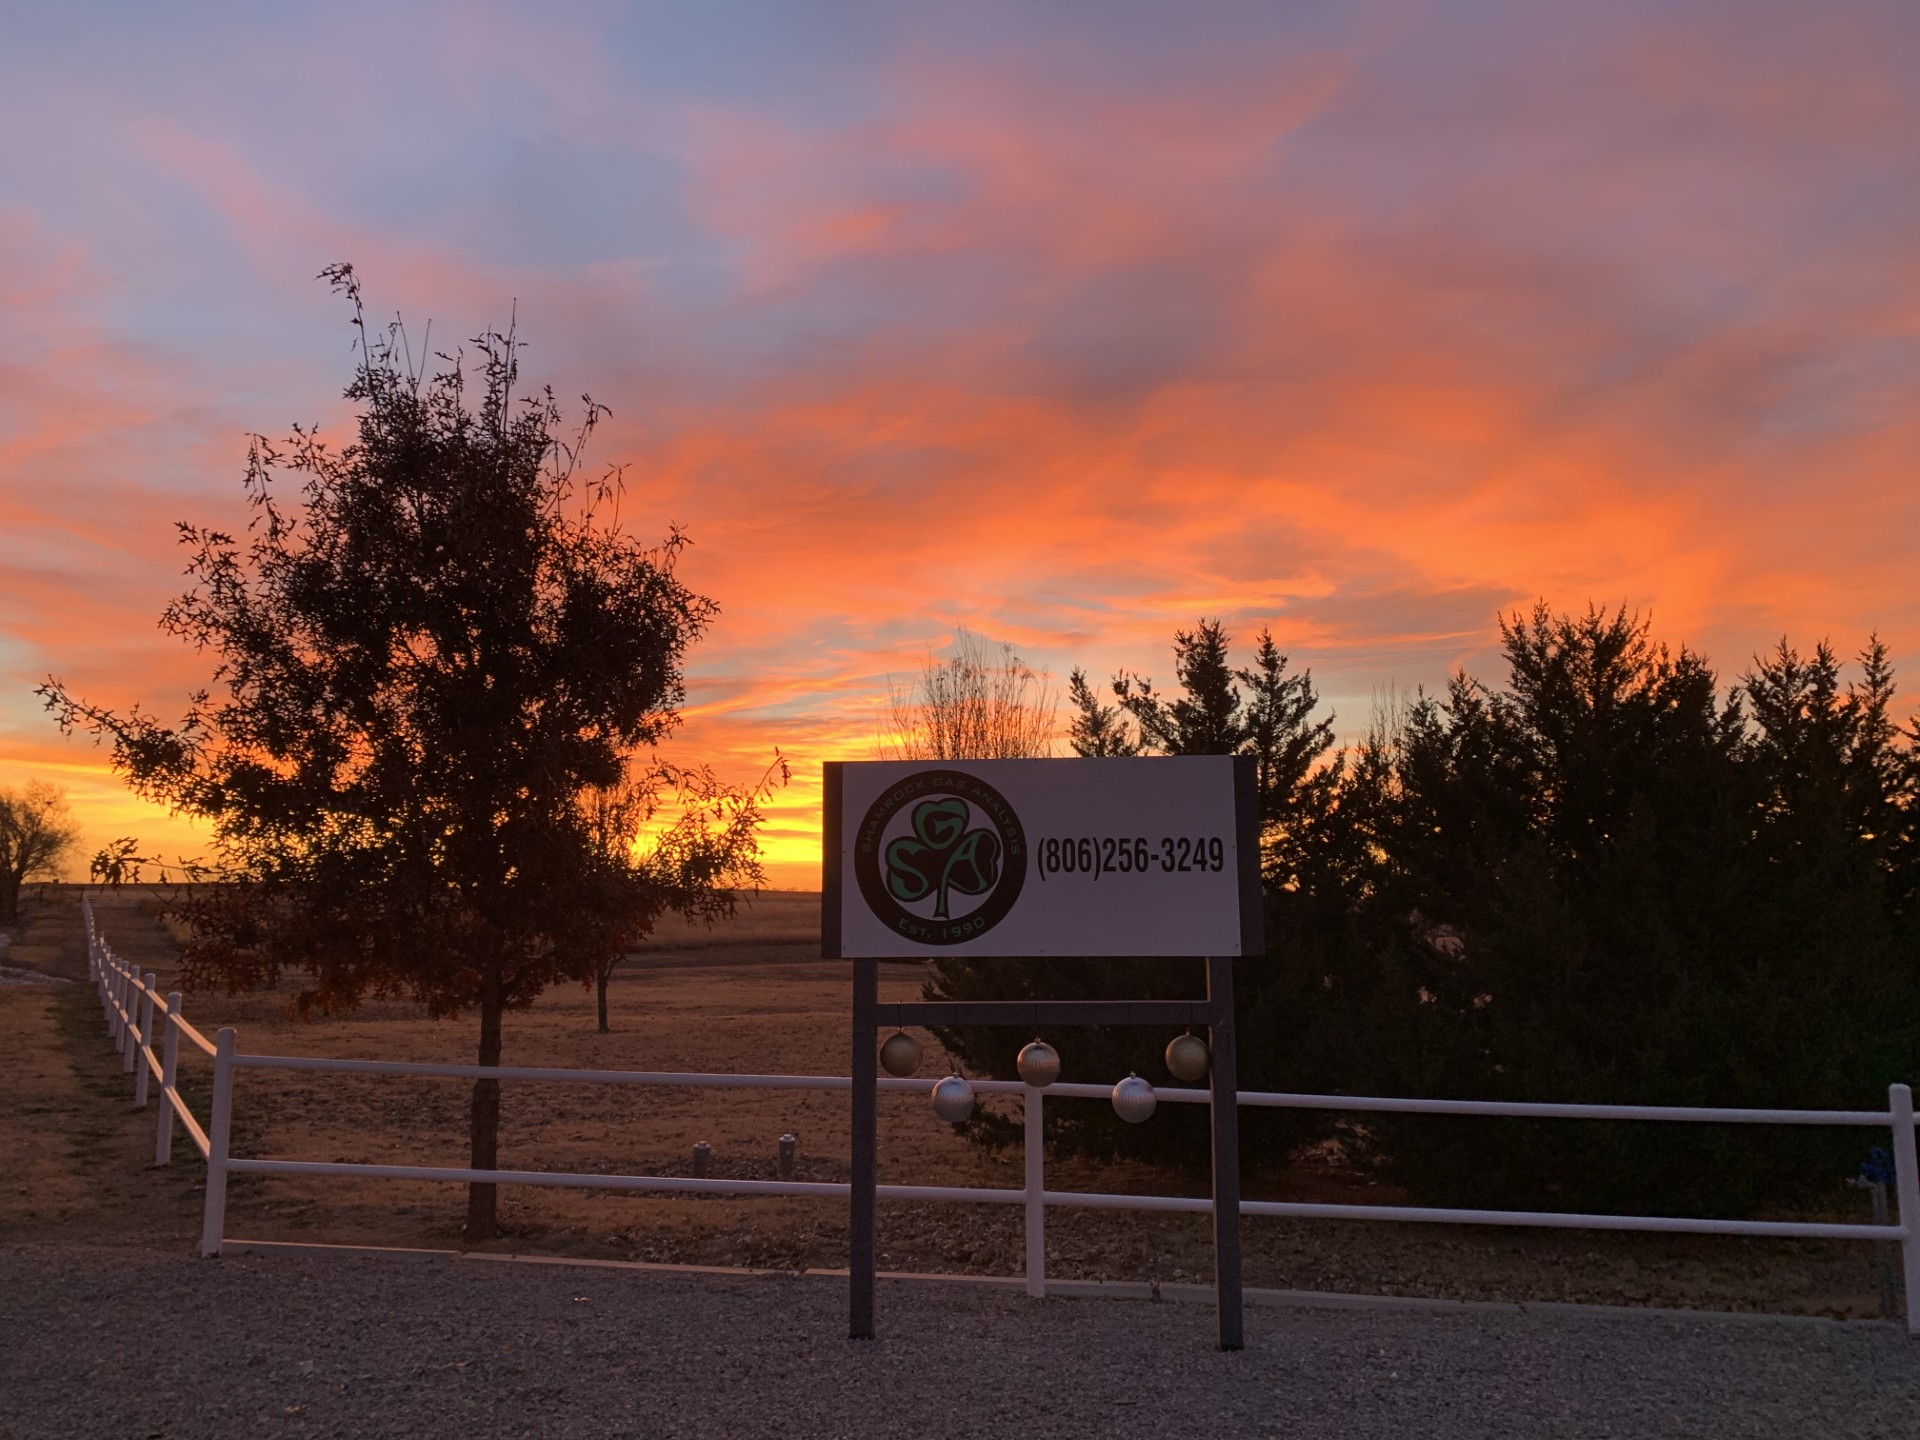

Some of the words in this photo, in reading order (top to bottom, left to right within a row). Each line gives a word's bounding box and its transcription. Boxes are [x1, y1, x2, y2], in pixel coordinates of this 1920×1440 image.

[863, 780, 926, 853] SHAMROCK
[932, 778, 967, 789] GAS
[971, 787, 1020, 855] ANALYSIS
[1038, 836, 1224, 881] (806)256-3249
[943, 916, 985, 939] 1990
